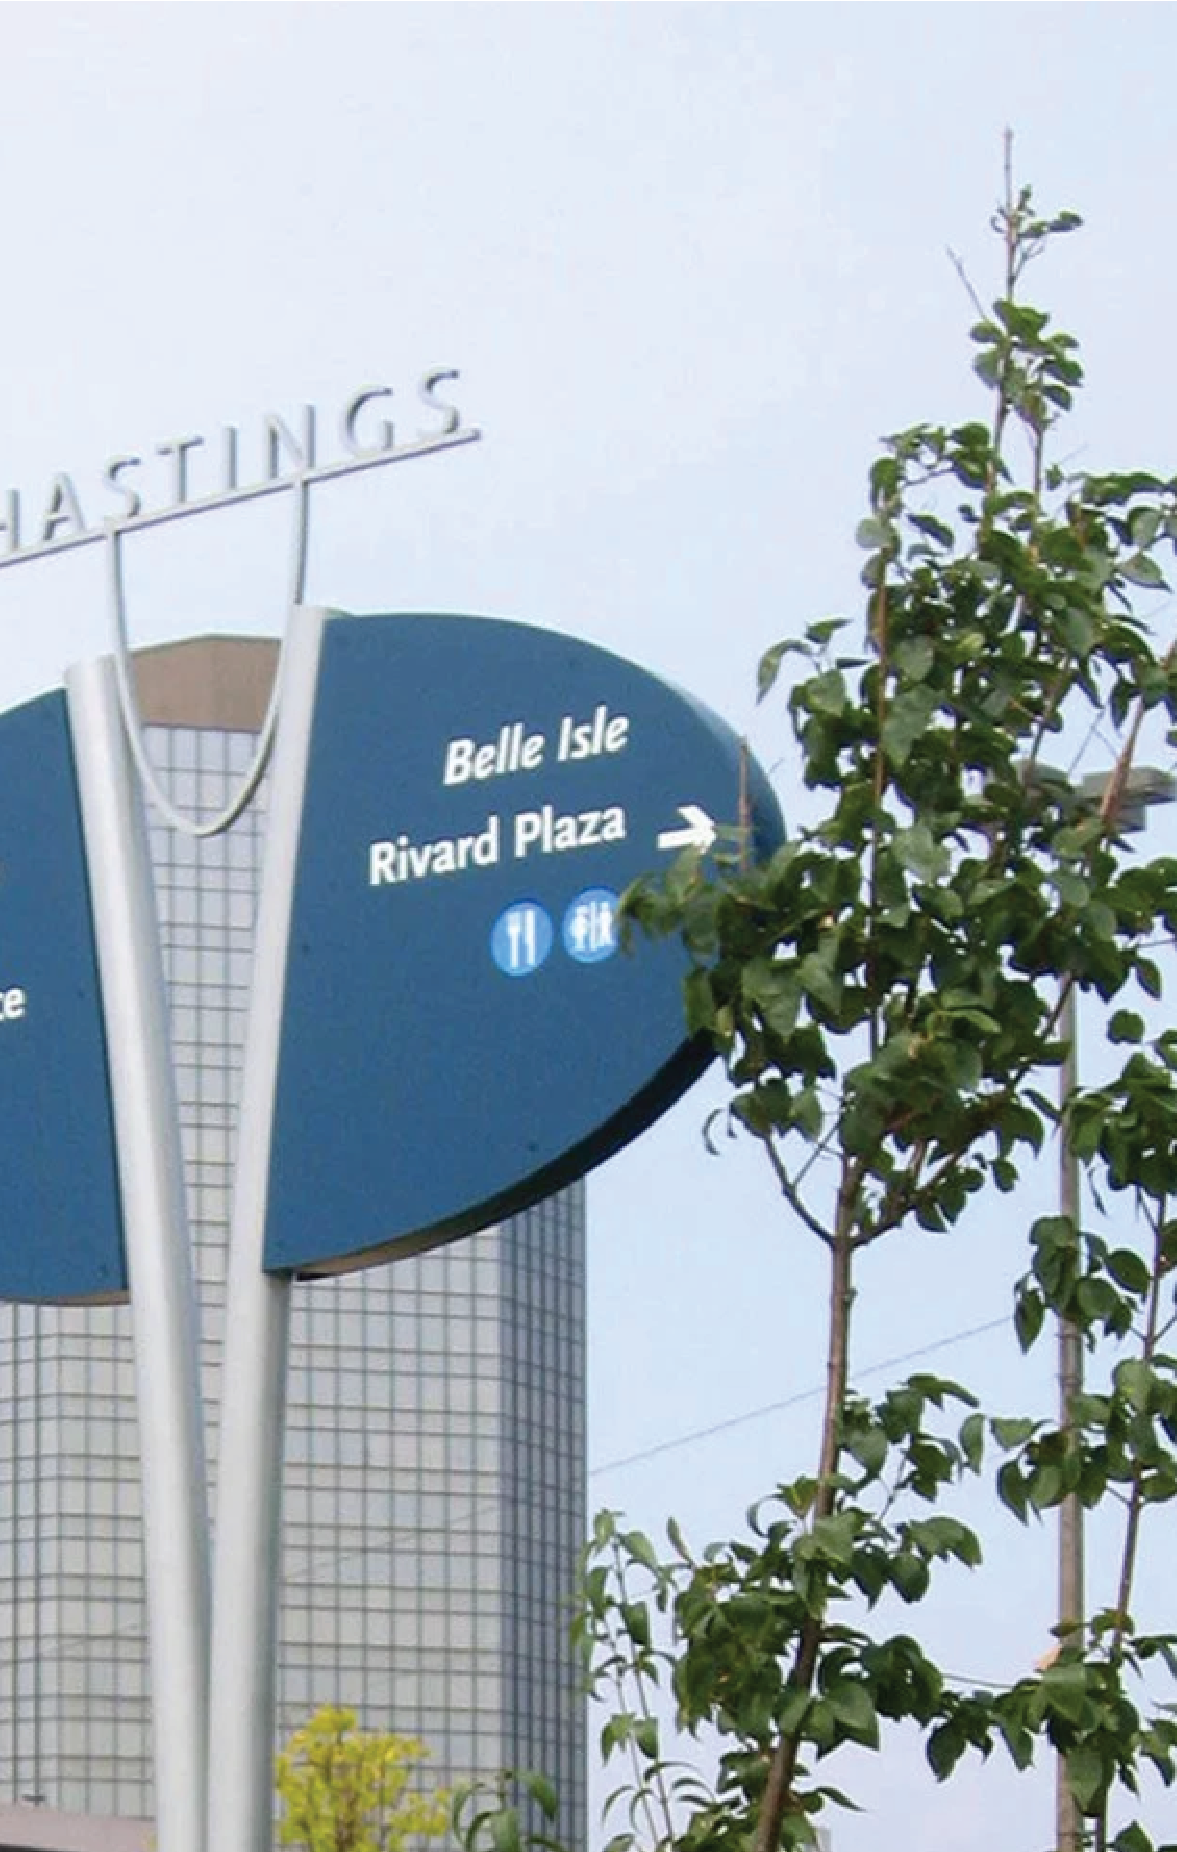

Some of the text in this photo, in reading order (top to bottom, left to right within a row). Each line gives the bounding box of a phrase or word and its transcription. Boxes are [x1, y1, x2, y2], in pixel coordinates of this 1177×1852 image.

[443, 705, 630, 786] Belle Isle
[369, 804, 627, 885] Rivard Plaza
